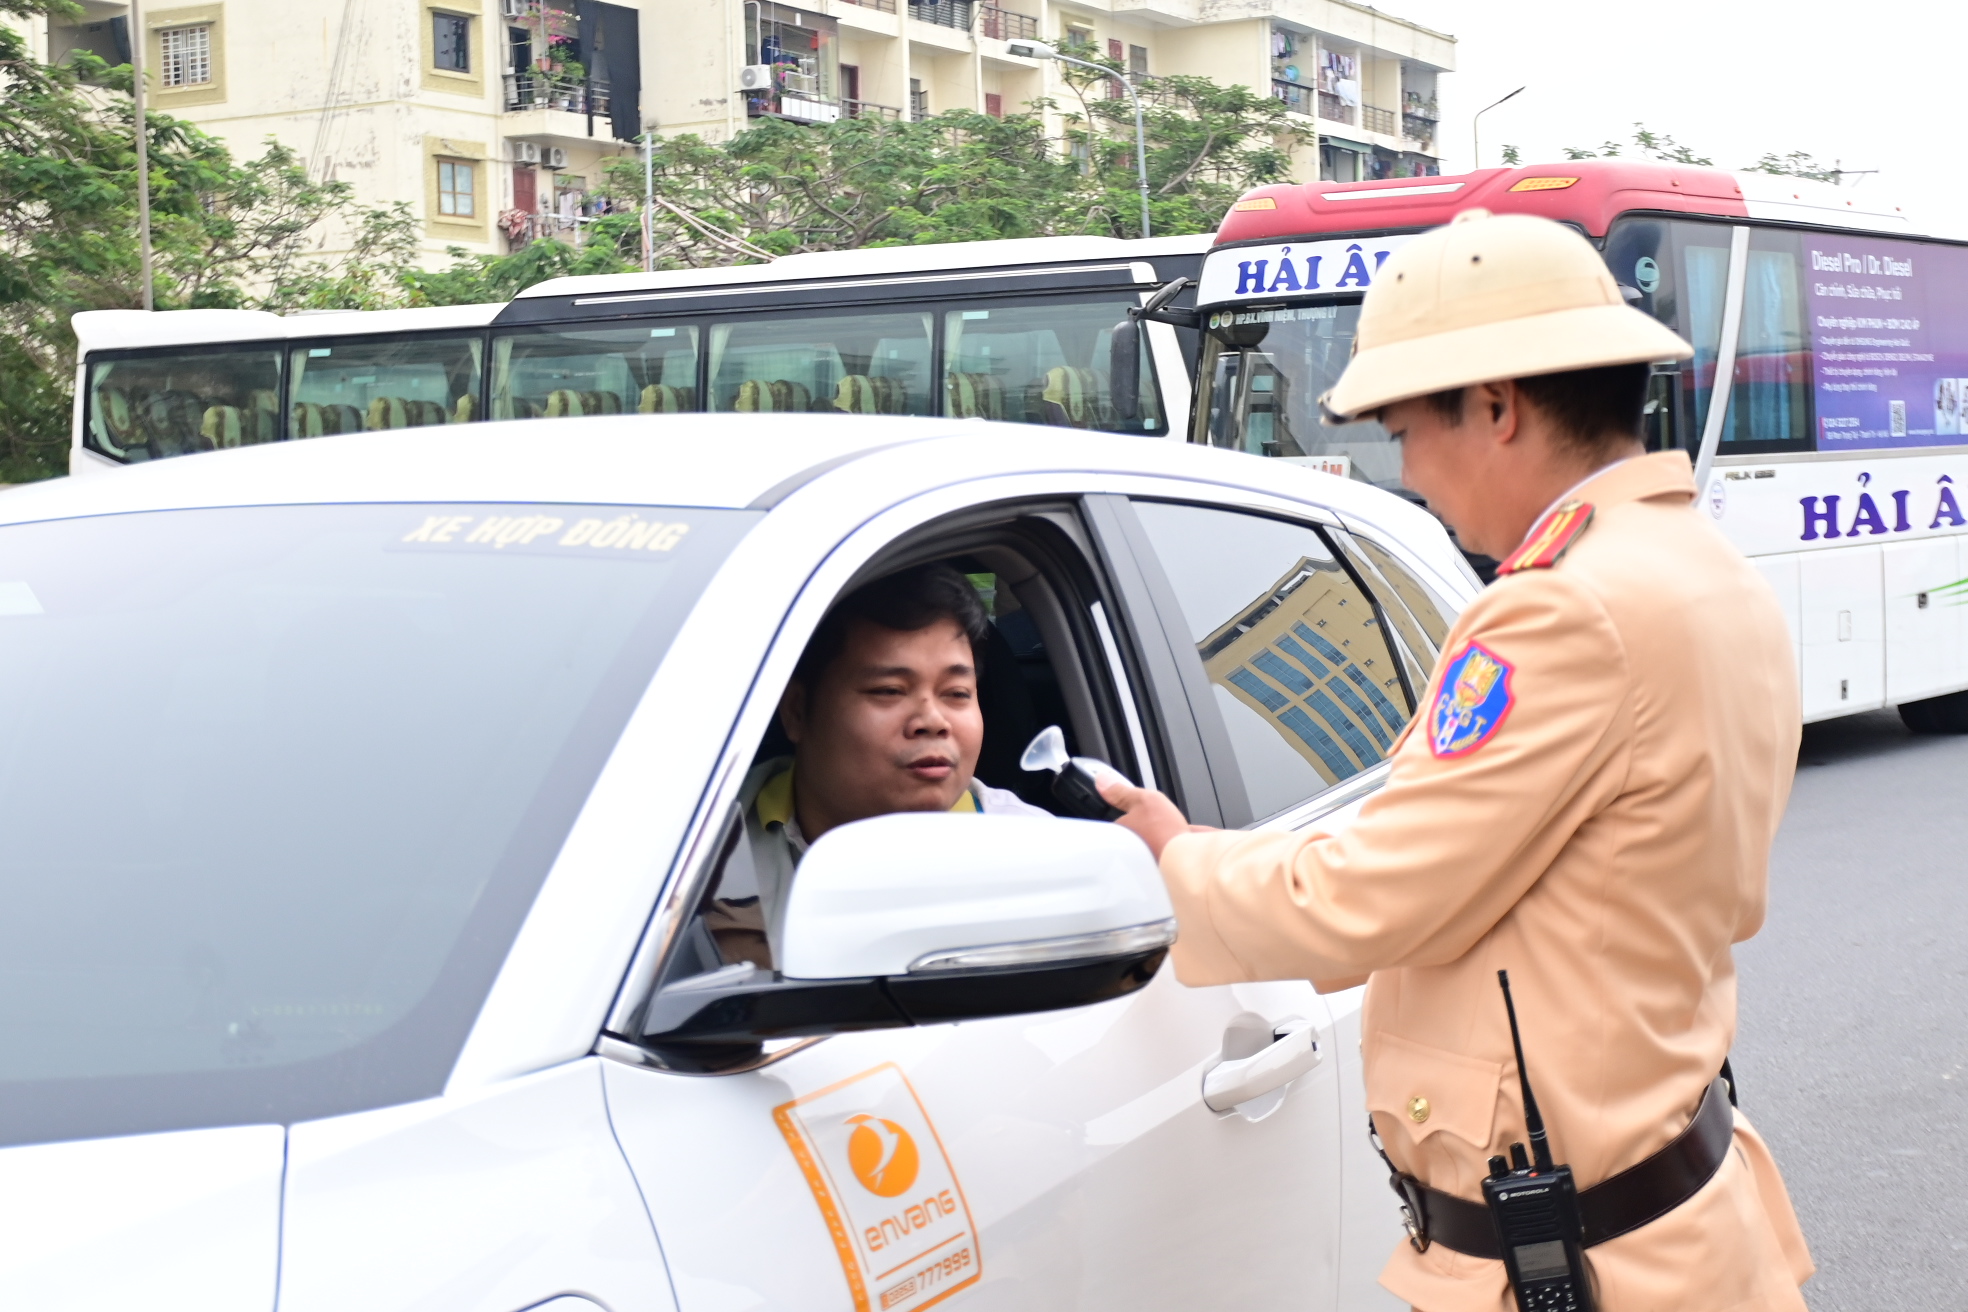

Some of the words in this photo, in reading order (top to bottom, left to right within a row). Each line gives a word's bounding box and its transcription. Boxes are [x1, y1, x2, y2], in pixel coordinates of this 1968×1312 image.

[1234, 246, 1322, 294] HẢI
[1811, 250, 1843, 272] Diesel
[1843, 253, 1862, 273] Pro
[1882, 256, 1912, 277] Diesel
[1799, 472, 1912, 541] HẢI
[401, 515, 474, 543] XE
[464, 513, 564, 549] HỢP
[558, 512, 690, 552] ĐỒNG
[1509, 1187, 1550, 1199] MOTOROLA
[916, 1247, 971, 1291] 777999
